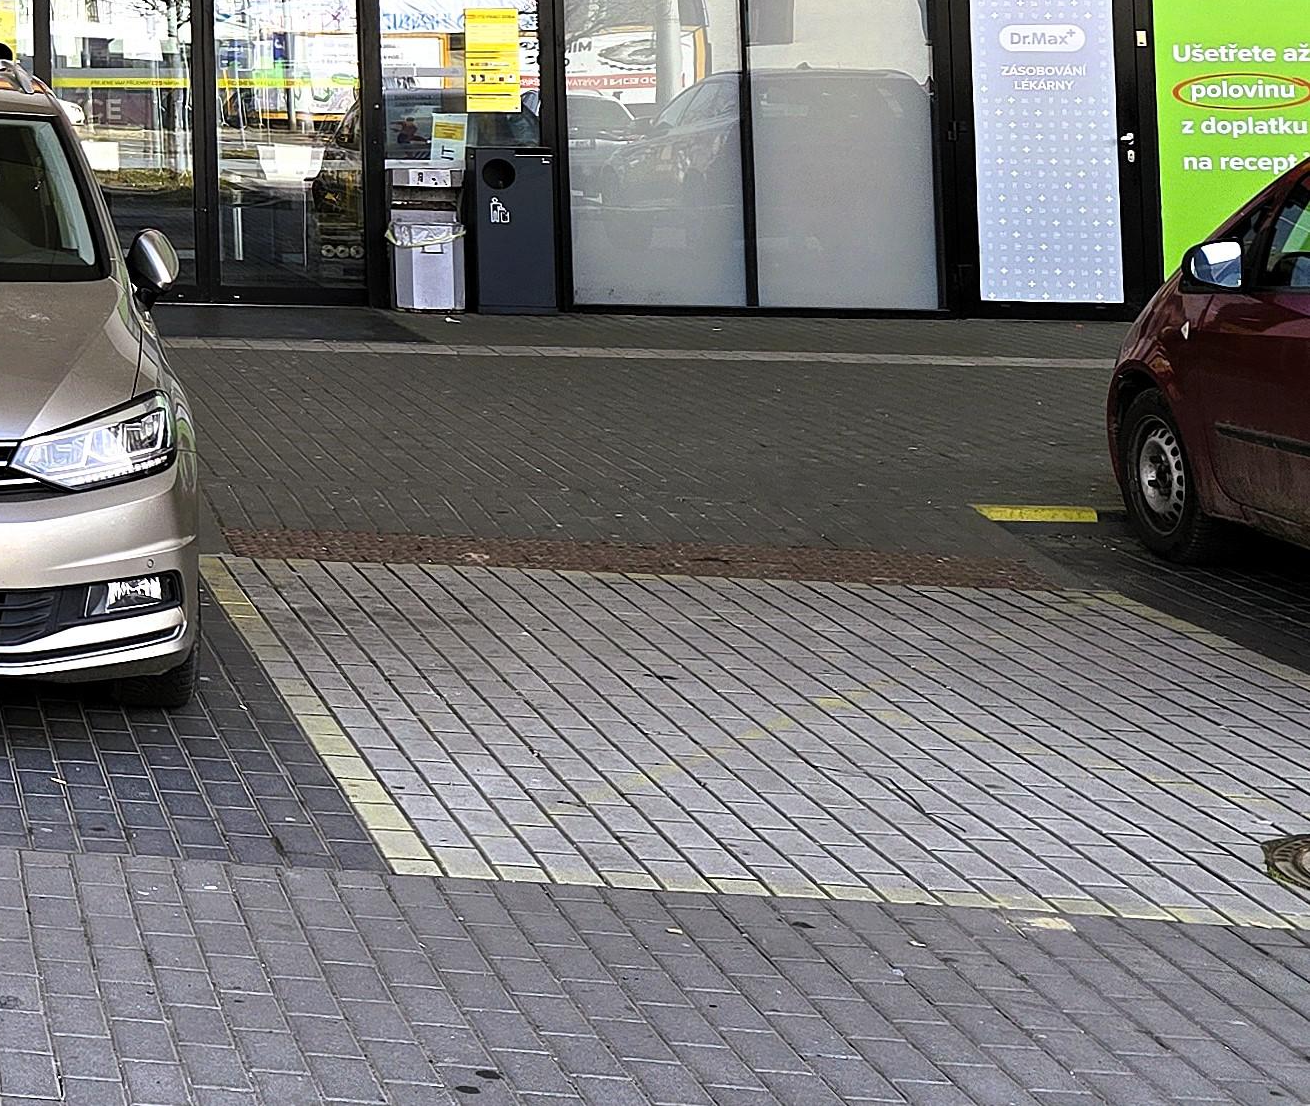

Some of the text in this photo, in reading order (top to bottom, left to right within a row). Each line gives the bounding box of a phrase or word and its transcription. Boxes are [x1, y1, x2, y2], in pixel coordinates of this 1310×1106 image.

[1172, 43, 1310, 63] Ušetřete až
[1000, 63, 1087, 76] ZÁSOBOVÁNÍ
[1013, 77, 1075, 91] LÉKÁRNY
[1191, 79, 1296, 104] polovinu
[1181, 117, 1309, 139] z doplatku
[1183, 152, 1298, 175] na recept
